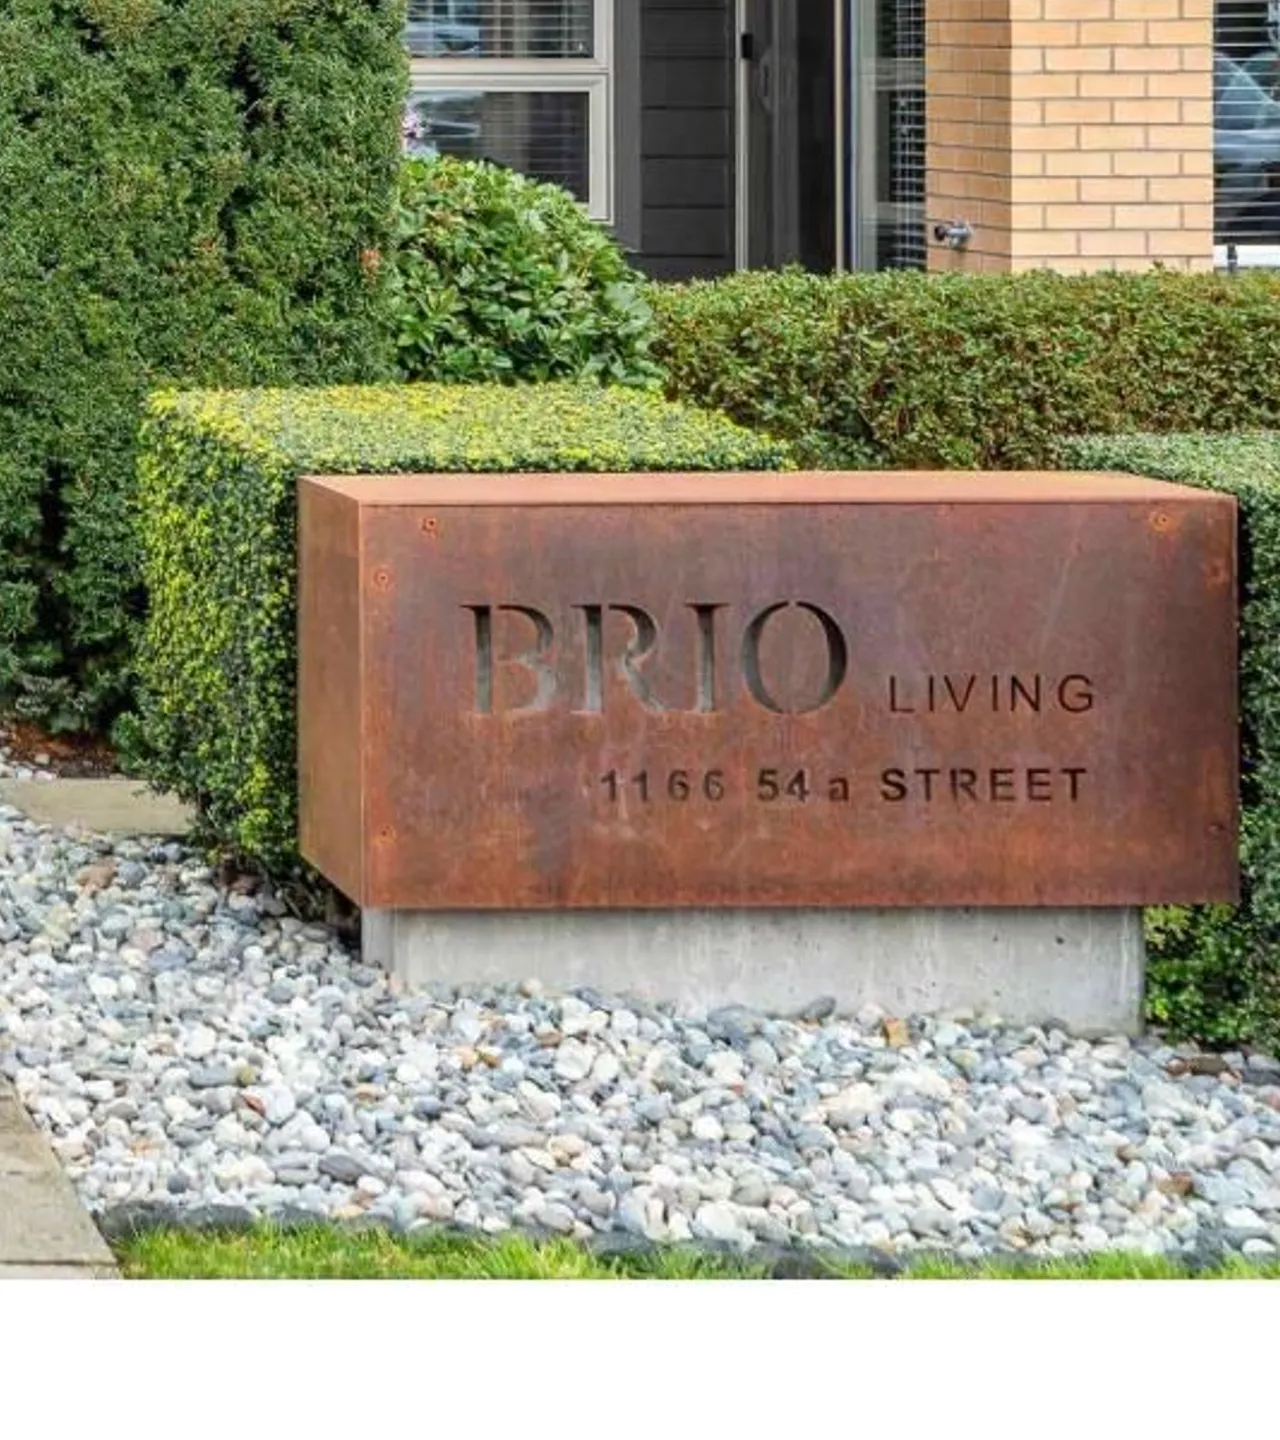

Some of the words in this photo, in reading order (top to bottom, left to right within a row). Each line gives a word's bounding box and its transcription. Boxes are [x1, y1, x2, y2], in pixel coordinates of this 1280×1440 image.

[459, 600, 848, 714] BRIO
[890, 673, 1094, 713] LIVING
[601, 768, 725, 802] 1166
[880, 767, 1088, 802] STREET
